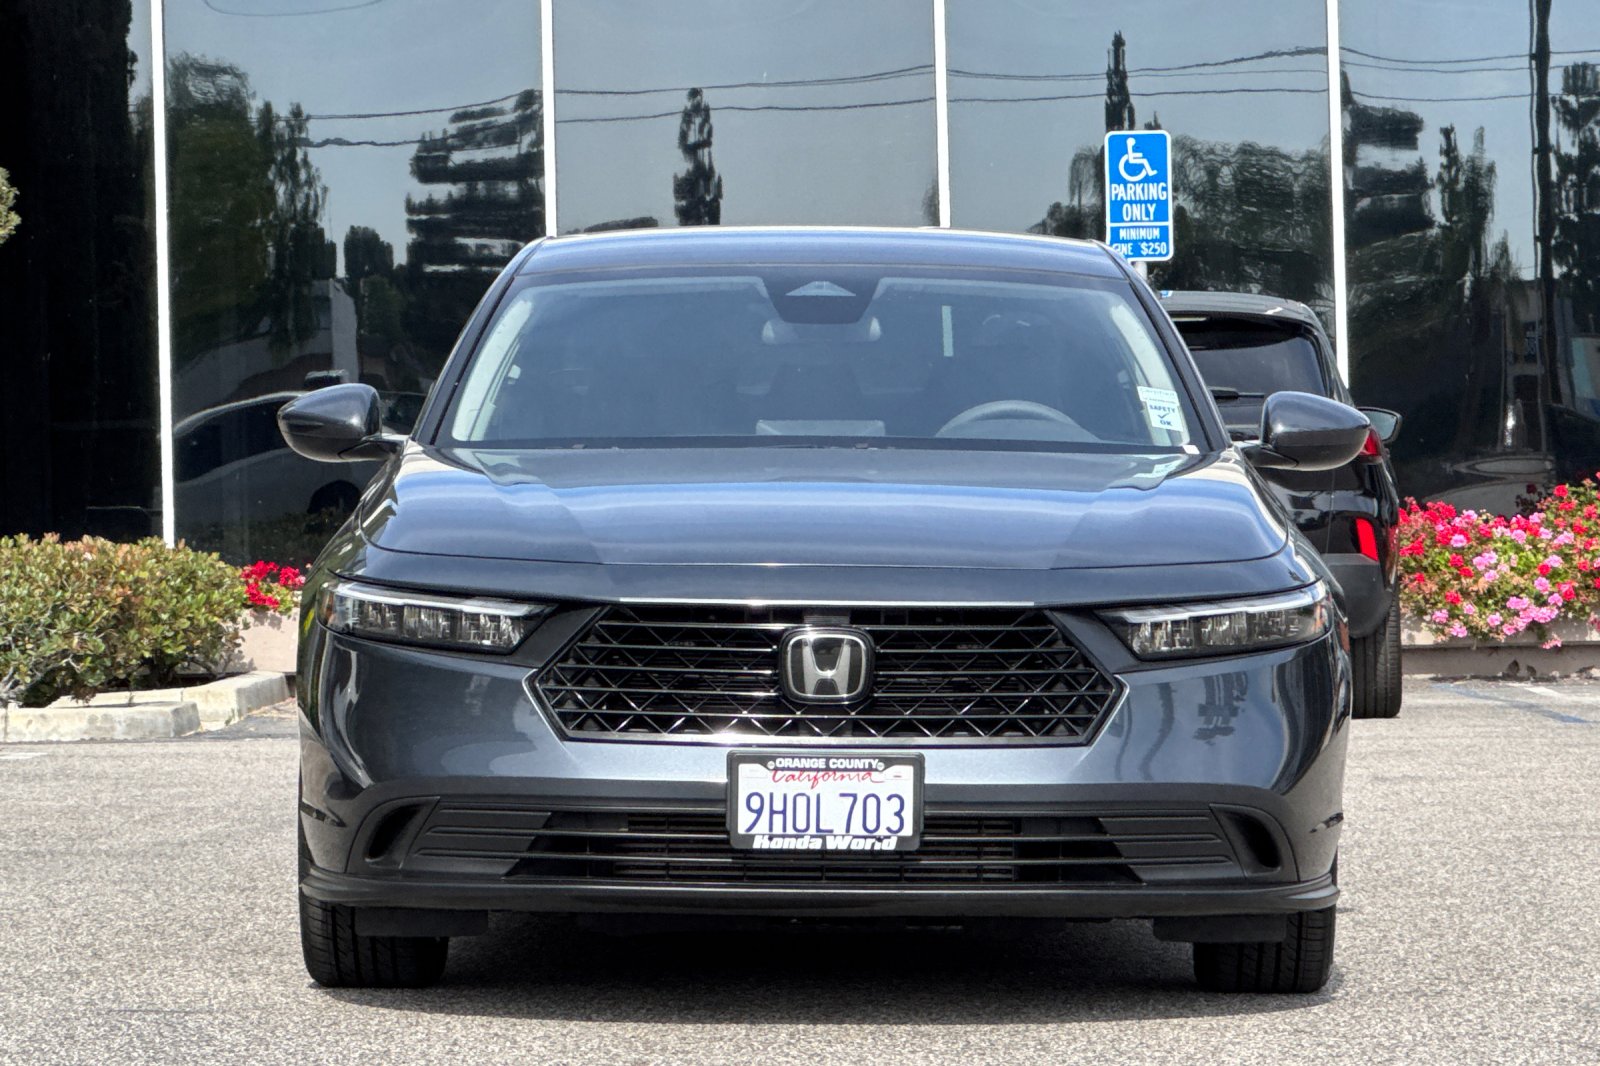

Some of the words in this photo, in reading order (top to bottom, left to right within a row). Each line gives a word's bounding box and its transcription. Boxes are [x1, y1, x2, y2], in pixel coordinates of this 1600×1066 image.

[1111, 182, 1167, 201] PARKING
[1122, 203, 1156, 221] ONLY
[1119, 228, 1160, 240] MINIMUM
[1140, 241, 1167, 256] $250
[1149, 404, 1175, 413] SAFETY
[775, 757, 827, 769] ORANGE
[829, 758, 879, 769] COUNTY
[772, 770, 885, 789] California
[752, 834, 822, 850] Honda
[826, 835, 898, 851] World
